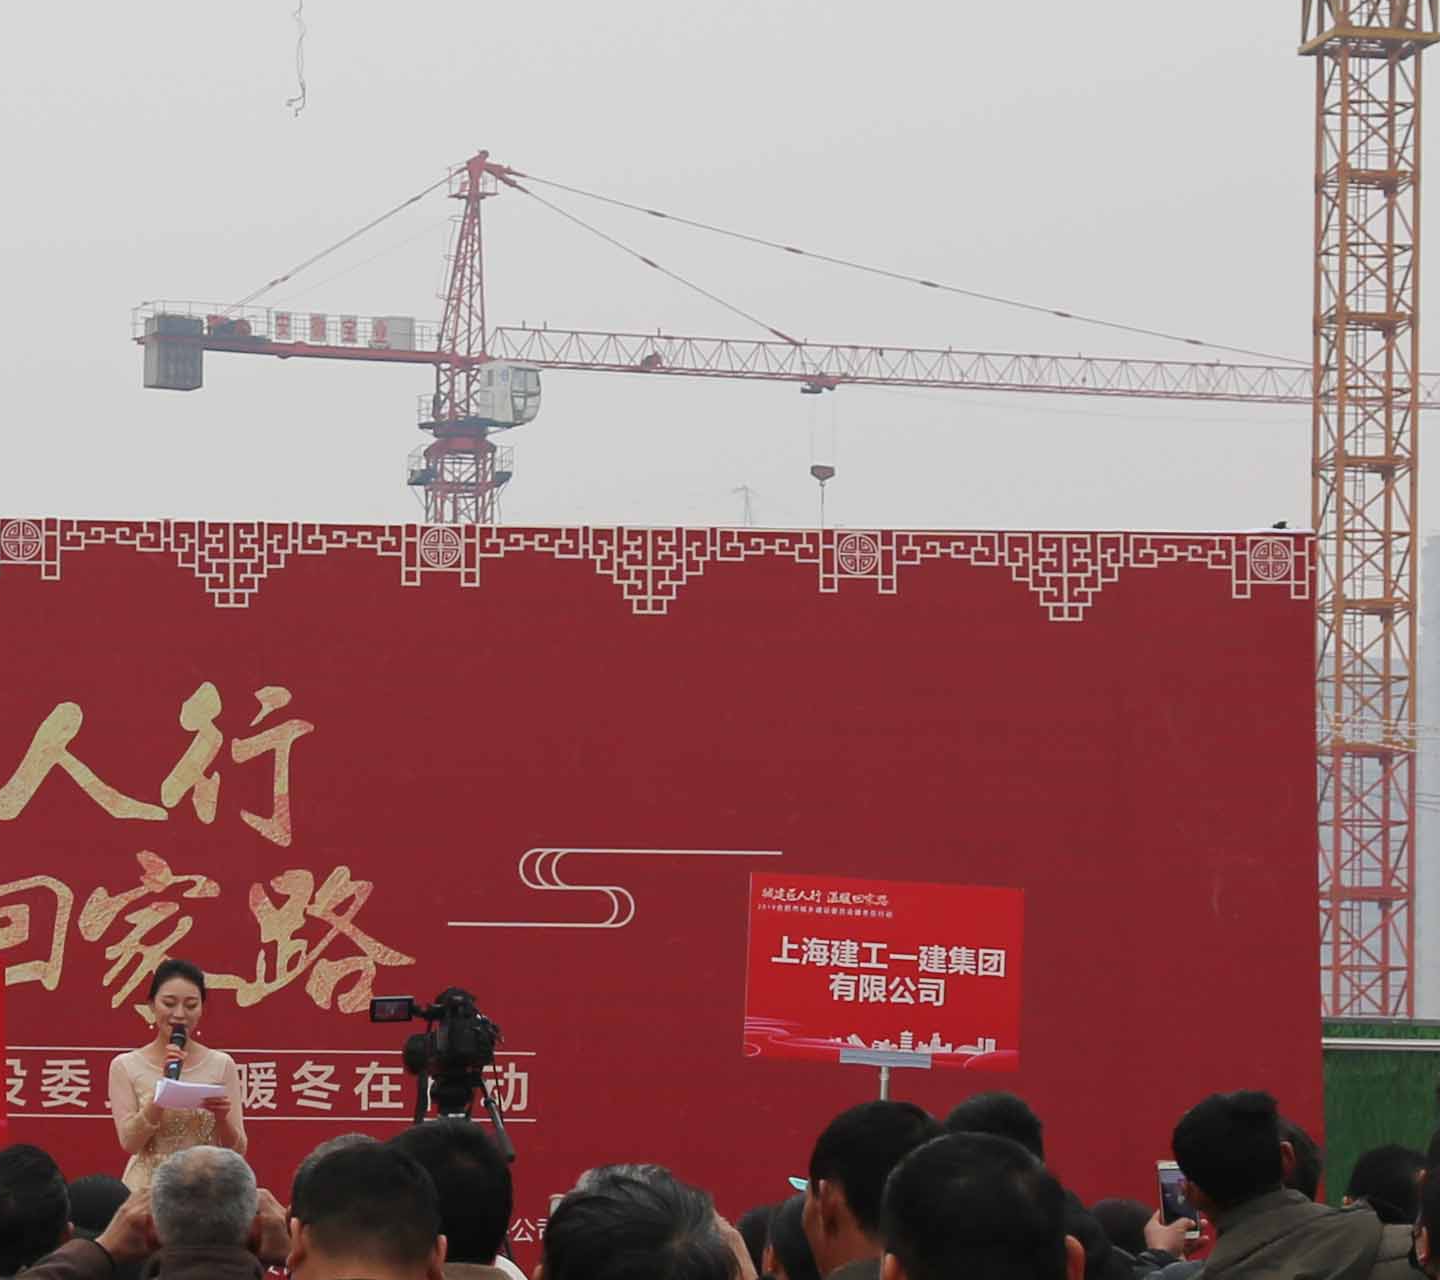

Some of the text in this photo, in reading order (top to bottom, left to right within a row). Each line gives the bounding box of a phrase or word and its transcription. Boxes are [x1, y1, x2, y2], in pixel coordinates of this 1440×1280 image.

[771, 935, 1006, 978] 上海建工一建集团
[829, 973, 945, 1007] 有限公司
